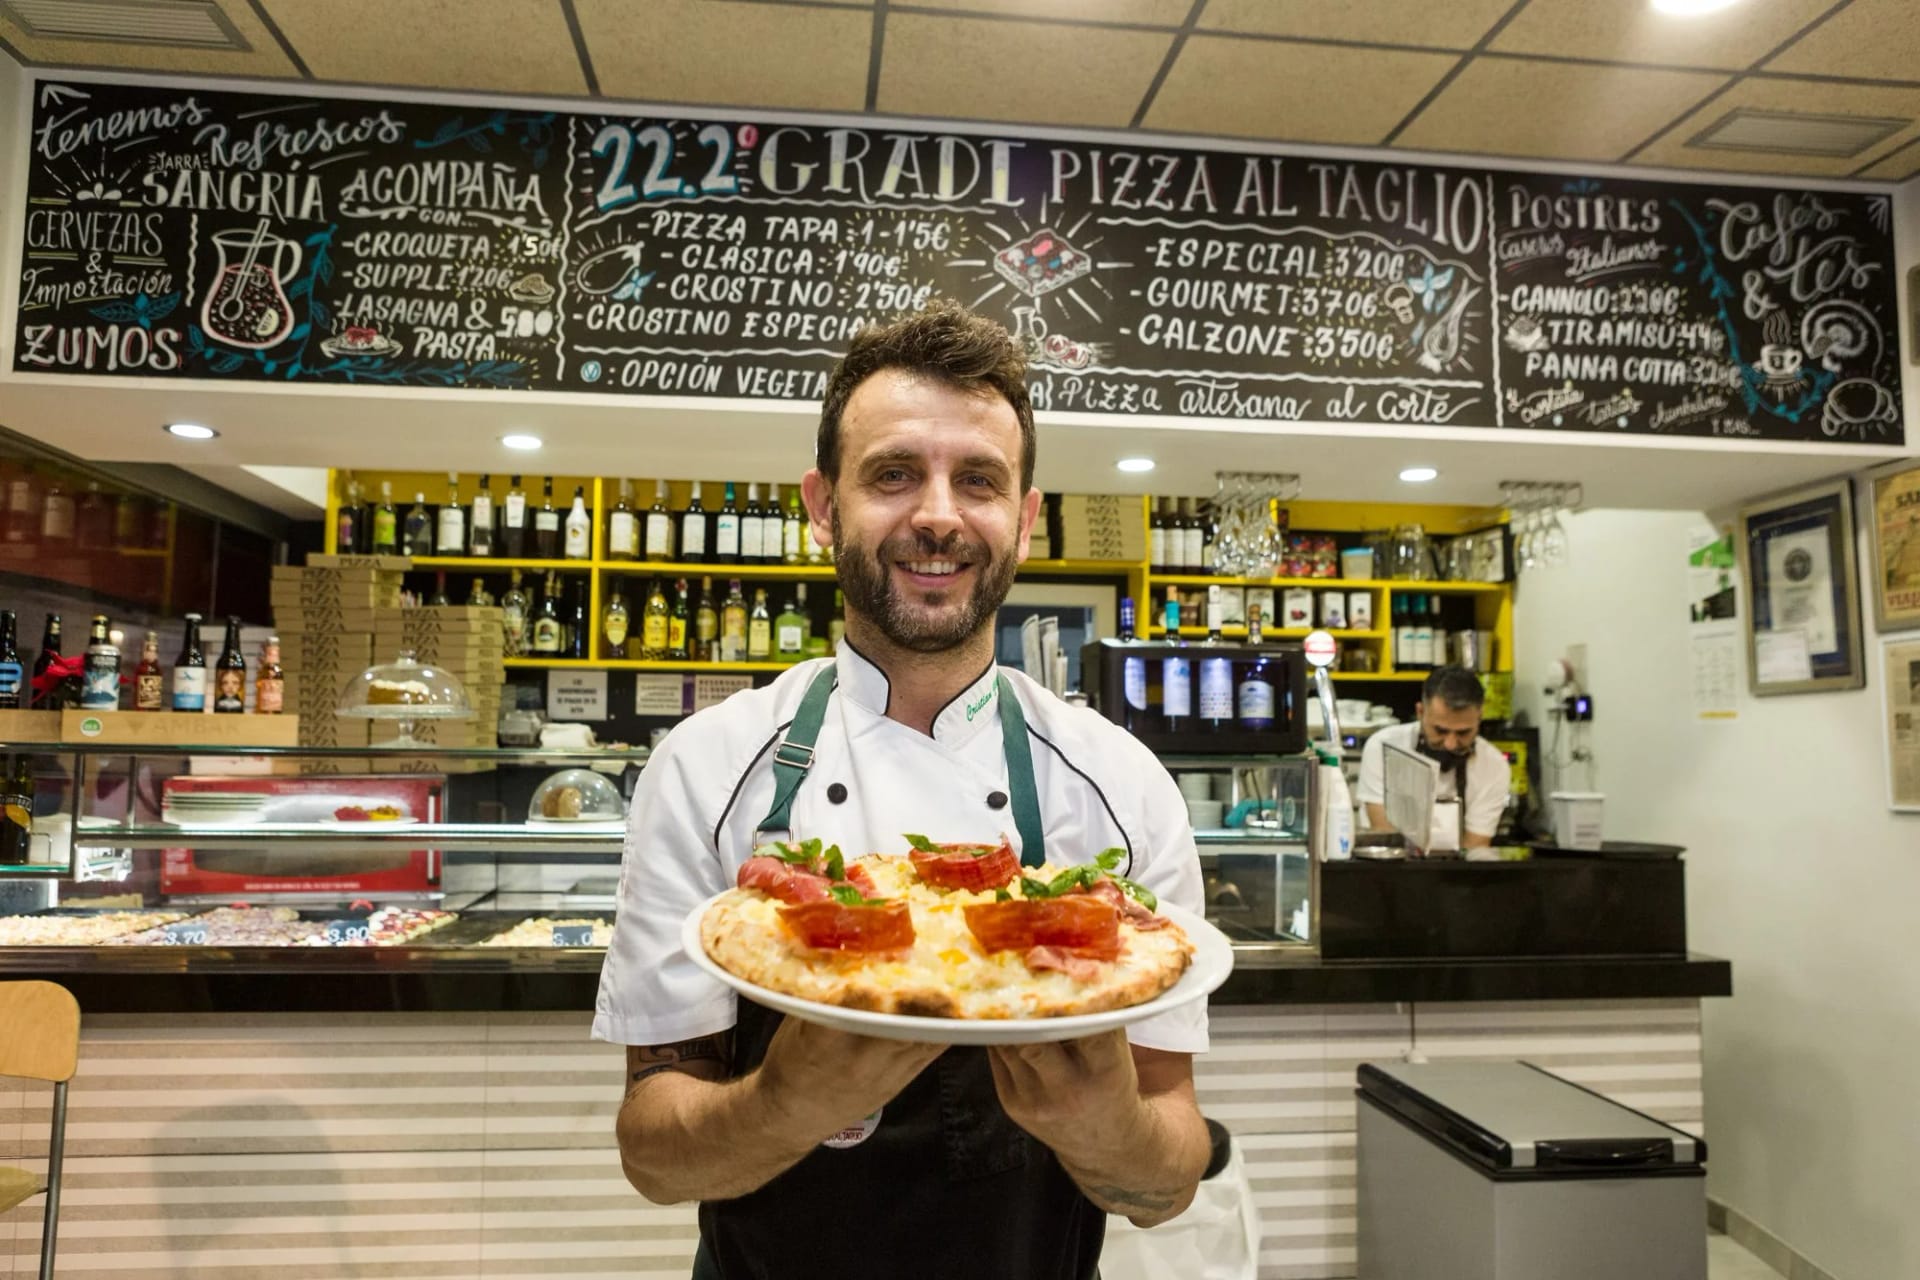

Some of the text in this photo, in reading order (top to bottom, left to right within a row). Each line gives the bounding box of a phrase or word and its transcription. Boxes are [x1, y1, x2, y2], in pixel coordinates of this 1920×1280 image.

[157, 153, 200, 170] JARRA
[143, 161, 327, 224] SANGRÍA
[341, 161, 549, 217] ACOMPAÑA
[759, 127, 1026, 205] GRADI
[1049, 149, 1217, 213] PIZZA
[1233, 158, 1298, 217] AL
[1308, 164, 1484, 254] TAGLIO
[1508, 185, 1661, 233] POSTRES
[28, 209, 163, 257] CERVEZAS
[86, 252, 103, 274] &
[464, 298, 494, 330] &
[1742, 270, 1780, 321] &
[20, 324, 182, 371] ZUMOS
[413, 328, 496, 361] PASTA
[1525, 351, 1618, 382] PANNA
[1175, 380, 1311, 420] artesana
[1326, 385, 1367, 419] al
